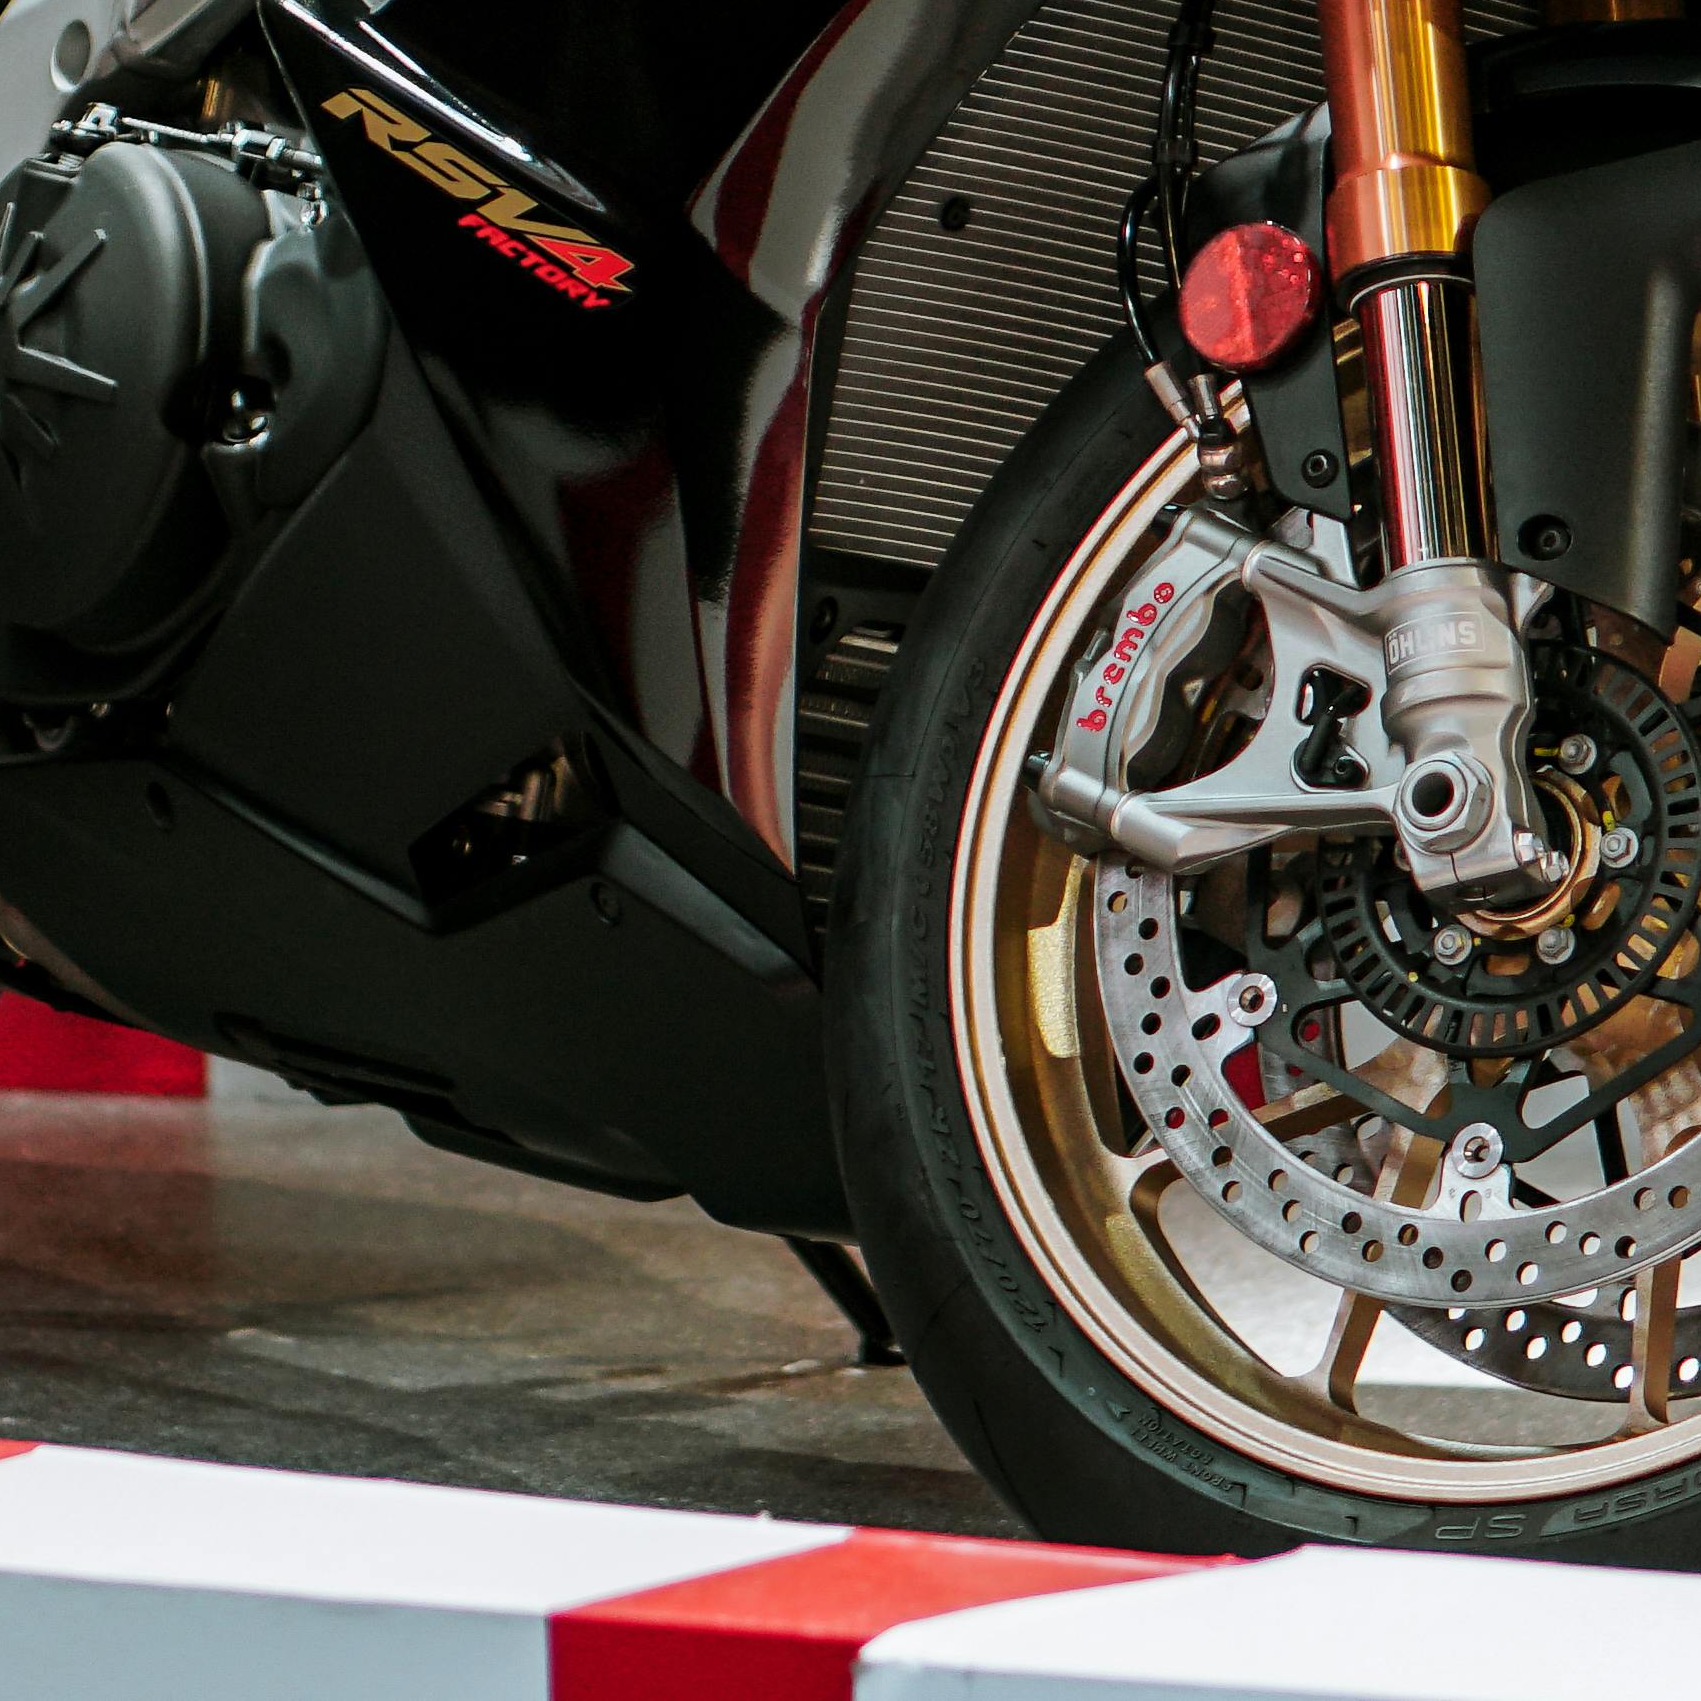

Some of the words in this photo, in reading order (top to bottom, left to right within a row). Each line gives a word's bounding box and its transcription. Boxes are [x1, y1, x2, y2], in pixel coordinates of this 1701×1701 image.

[320, 87, 635, 293] RSV4
[457, 212, 612, 311] FACTORY
[1076, 581, 1175, 733] brembo
[1434, 1513, 1526, 1541] SP
